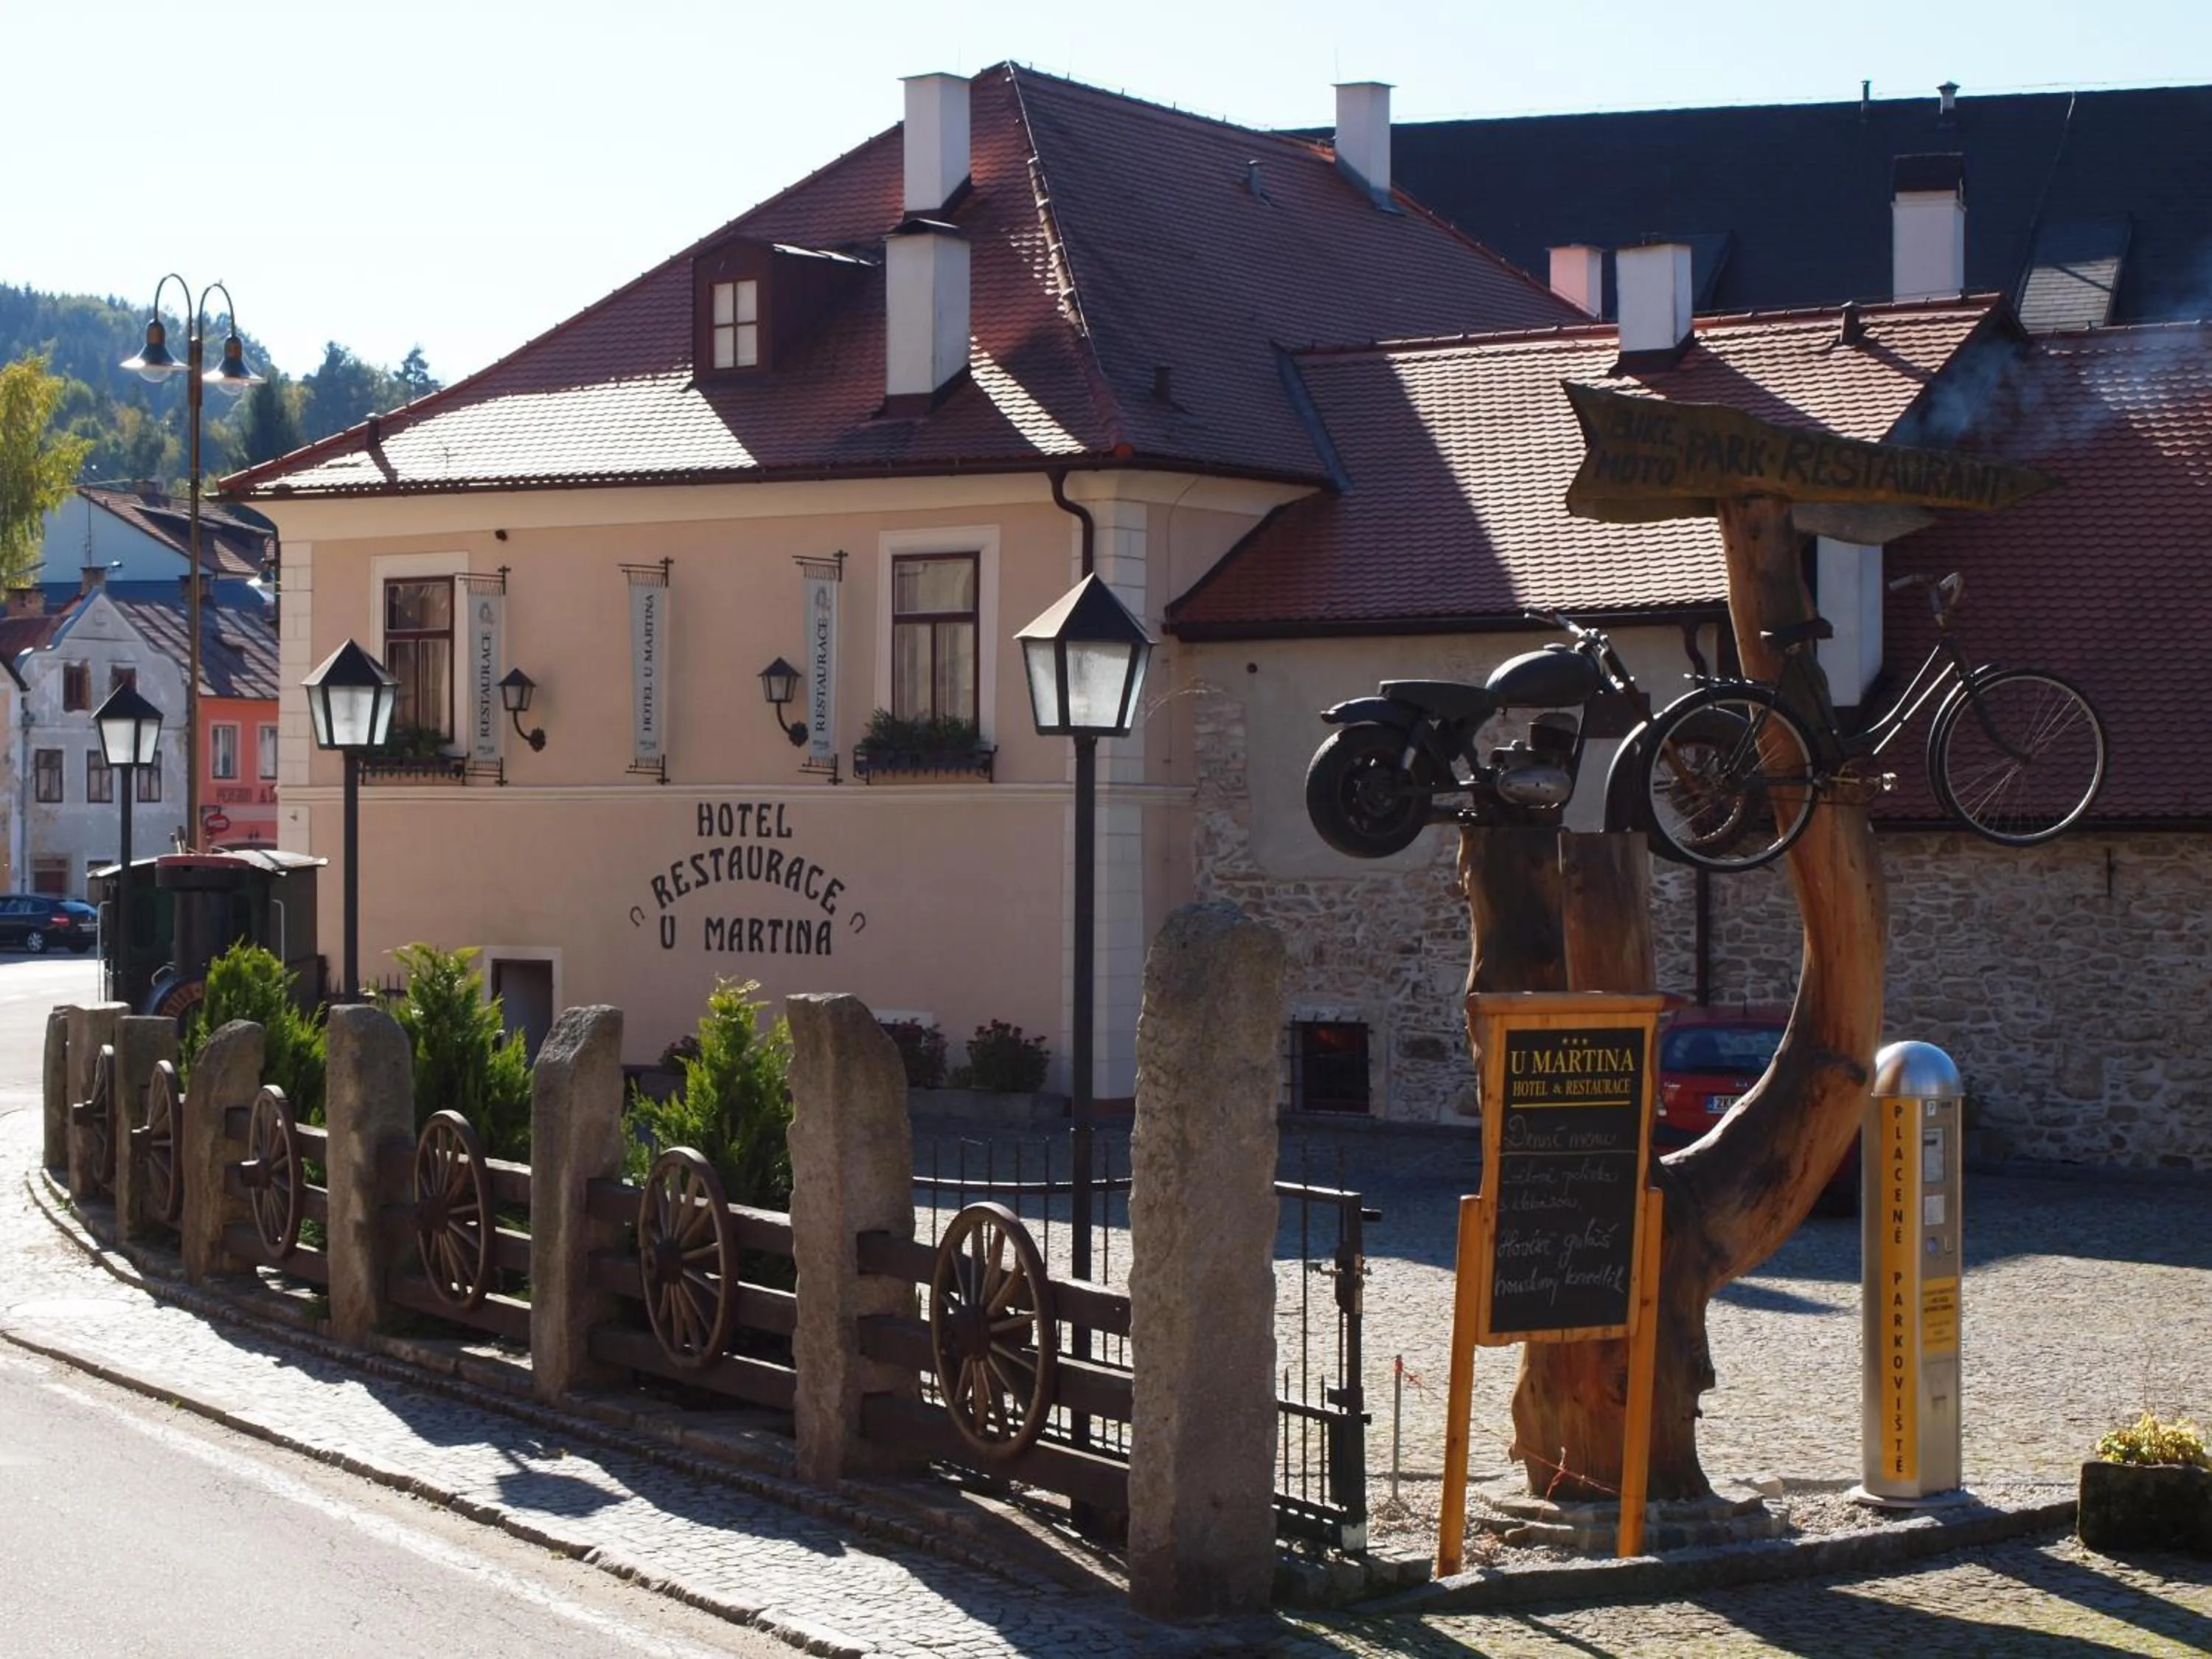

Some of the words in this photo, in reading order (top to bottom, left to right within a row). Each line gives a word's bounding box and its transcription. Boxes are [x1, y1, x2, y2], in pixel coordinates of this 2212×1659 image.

[1593, 451, 1679, 487] MOTO
[1684, 431, 1767, 477] PARK
[644, 594, 653, 661] MARTINA
[480, 631, 490, 737] RESTAURACE
[644, 667, 653, 677] U
[815, 617, 827, 731] RESTAURACE
[644, 682, 653, 731] HOTEL
[697, 803, 793, 838] HOTEL
[650, 845, 846, 915] RESTAURACE
[660, 915, 675, 950] U
[704, 917, 832, 956] MARTINA
[1510, 1051, 1526, 1074] U
[1531, 1048, 1635, 1074] MARTINA
[1512, 1079, 1547, 1096] HOTEL
[1552, 1082, 1563, 1094] &
[1565, 1078, 1631, 1095] RESTAURACE
[1893, 1105, 1903, 1245] PLACENÉ
[1893, 1272, 1904, 1473] PARKOVIŠTĚ
